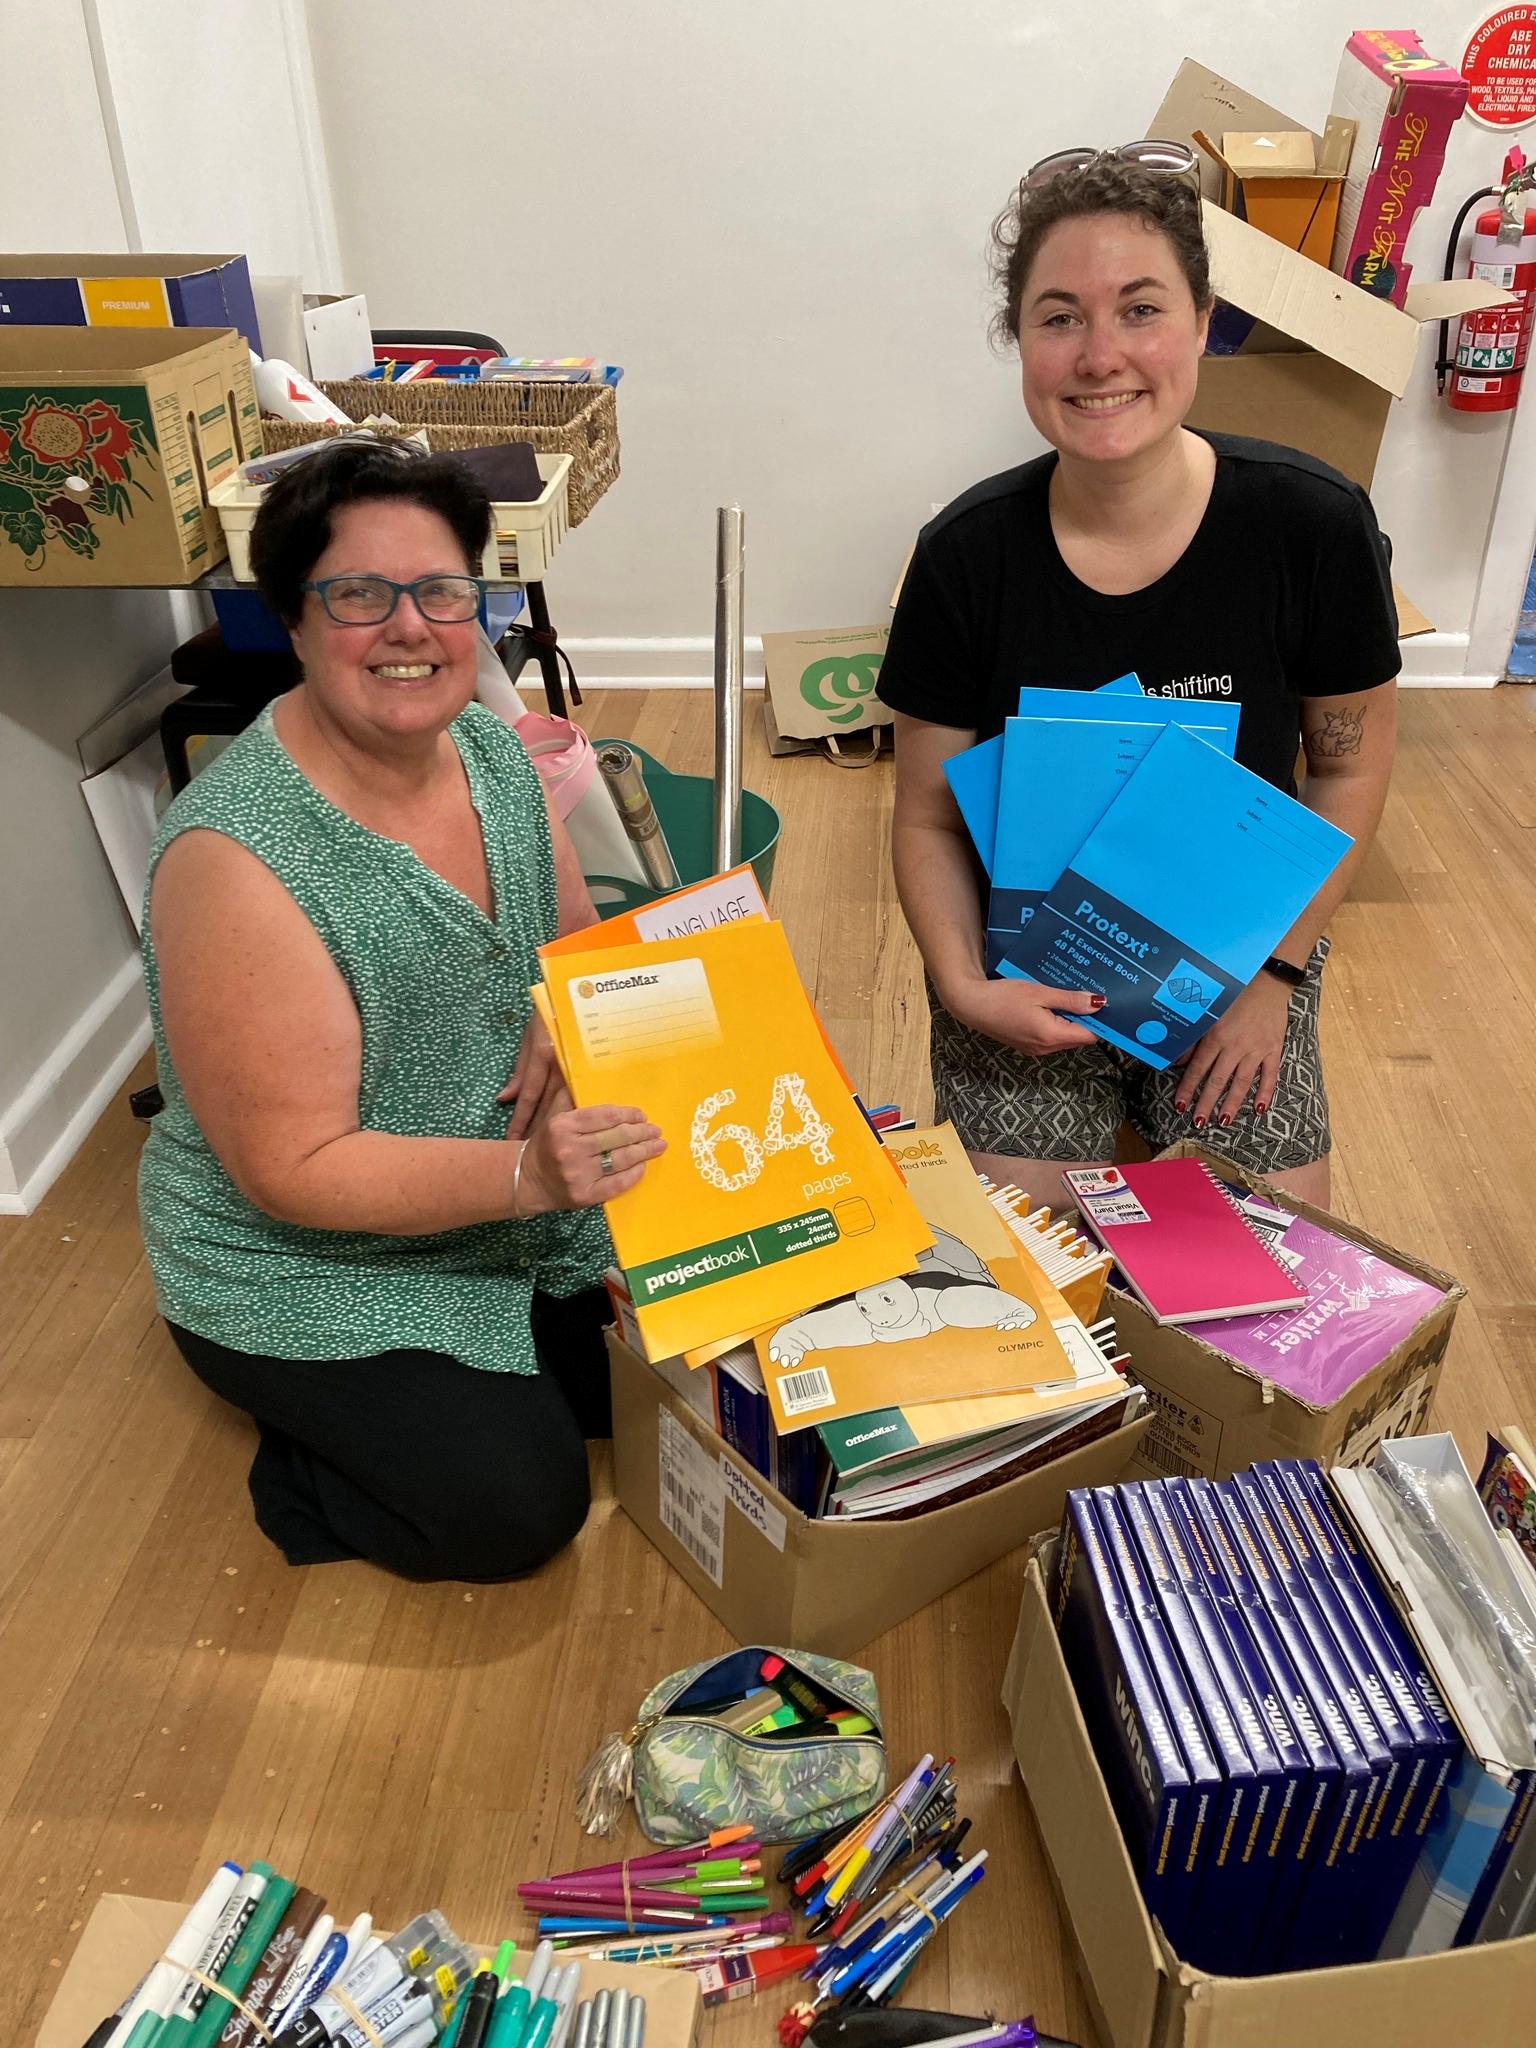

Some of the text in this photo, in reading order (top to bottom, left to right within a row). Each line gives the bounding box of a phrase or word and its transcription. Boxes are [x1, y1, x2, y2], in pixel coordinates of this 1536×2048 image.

[1465, 10, 1527, 70] THIS COLOURED
[1508, 44, 1530, 55] DRY
[1510, 30, 1532, 41] ABE
[1488, 57, 1536, 70] CHEMICA
[1472, 86, 1492, 95] WOOD,
[1487, 77, 1495, 85] TO
[1496, 77, 1505, 85] BE
[1507, 77, 1523, 85] USED
[1478, 103, 1515, 112] ELECTRICAL
[1497, 95, 1518, 103] LIQUID
[102, 301, 149, 310] PREMIUM
[1142, 674, 1232, 699] is shifting
[1246, 809, 1262, 822] Subject
[1255, 797, 1268, 806] Name
[1237, 822, 1249, 832] Class
[1074, 900, 1149, 959] Protext
[1054, 939, 1090, 967] 48 Page
[1061, 929, 1139, 984] A4 Exercise Book
[596, 975, 659, 993] OfficeMax
[1041, 966, 1067, 986] Red Margin
[1044, 961, 1061, 977] Activity
[1060, 972, 1073, 983] Page
[1051, 953, 1106, 993] 24mm Dotted Thirds
[1170, 1013, 1189, 1027] reference
[690, 1073, 834, 1192] 64
[890, 1140, 942, 1160] ook
[900, 1158, 947, 1171] tted thirds
[802, 1171, 851, 1200] pages
[1080, 1185, 1095, 1193] A5
[1094, 1206, 1114, 1214] Diary
[1115, 1203, 1139, 1211] Visual
[777, 1212, 829, 1234] 335 x 245mm
[807, 1221, 833, 1235] 24mm
[786, 1230, 837, 1253] dotted thirds
[645, 1244, 750, 1295] projectbook
[1270, 1299, 1345, 1354] writer
[998, 1341, 1044, 1353] OLYMPIC
[1139, 1384, 1187, 1419] riter
[845, 1424, 898, 1447] OfficeMax
[1150, 1431, 1172, 1447] OUTER
[1177, 1435, 1196, 1450] BOOK
[1177, 1440, 1200, 1458] THIRDS
[725, 1461, 765, 1512] Dotted
[727, 1482, 766, 1530] Thirds
[1078, 1501, 1095, 1531] punched
[1130, 1496, 1148, 1525] punched
[1152, 1492, 1171, 1522] punched
[1264, 1475, 1310, 1558] sheet protectors punched
[1286, 1472, 1334, 1554] sheet protectors punched
[1308, 1472, 1358, 1554] sheet protectors punched
[1166, 1522, 1185, 1558] protectors
[1175, 1490, 1216, 1575] sheet protectors punched
[1199, 1491, 1242, 1576] sheet protectors punched
[1224, 1495, 1270, 1579] sheet protectors punched
[1245, 1486, 1291, 1570] sheet protectors punched
[1181, 1557, 1193, 1578] sheet
[1366, 1674, 1399, 1726] winc.
[1391, 1671, 1424, 1723] winc.
[1416, 1672, 1450, 1723] winc.
[1212, 1702, 1241, 1755] winc.
[1238, 1698, 1267, 1752] winc.
[1264, 1695, 1294, 1747] winc.
[1293, 1696, 1324, 1749] winc.
[1324, 1700, 1356, 1753] winc.
[1346, 1688, 1379, 1742] winc.
[1149, 1710, 1176, 1763] winc.
[1179, 1707, 1207, 1760] winc.
[279, 1954, 308, 2004] Sharpie
[349, 2000, 400, 2039] BARD
[353, 2006, 404, 2048] MSTER
